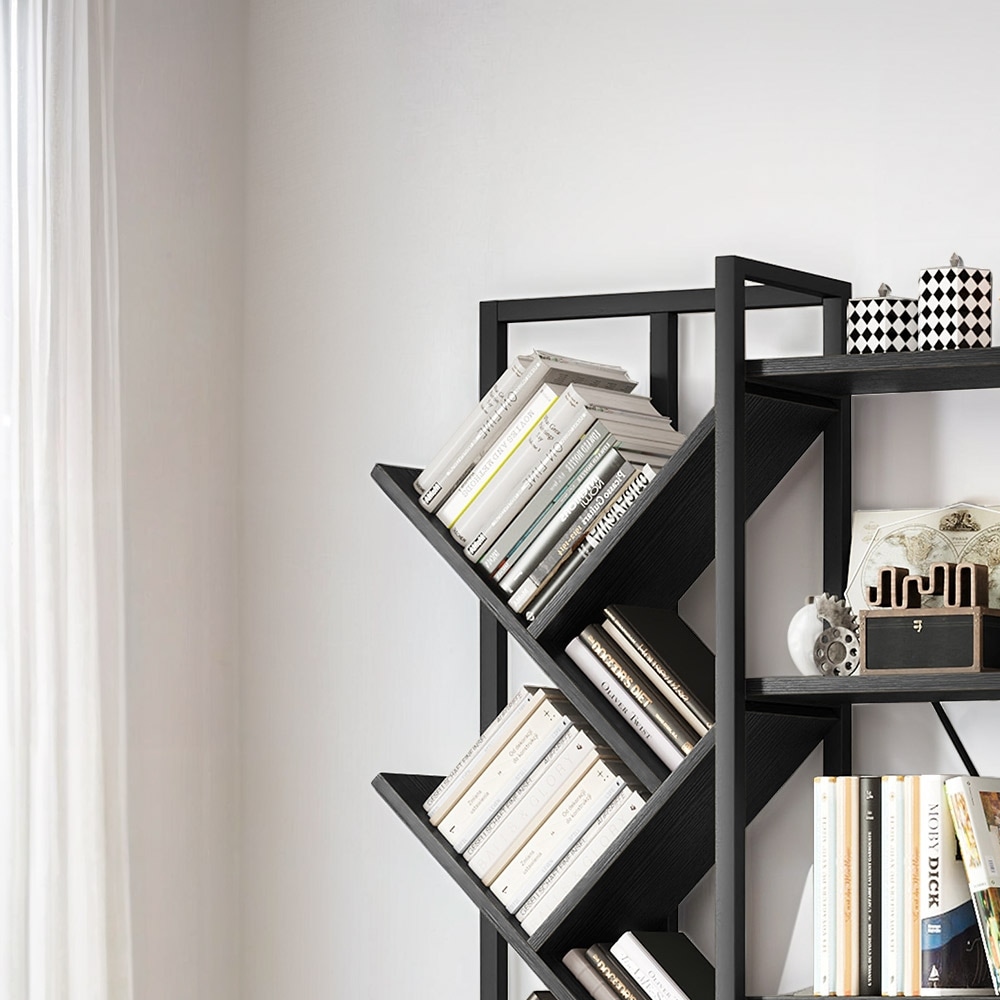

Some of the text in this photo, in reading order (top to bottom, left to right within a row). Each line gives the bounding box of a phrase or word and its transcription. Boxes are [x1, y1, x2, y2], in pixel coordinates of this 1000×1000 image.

[504, 409, 536, 444] MOVIES
[490, 440, 509, 460] AND
[459, 458, 494, 498] METHODS
[598, 679, 654, 740] OLIVER TWIST
[629, 683, 652, 709] DIET
[928, 804, 939, 908] MOBY DICK
[645, 968, 673, 999] OLIVER
